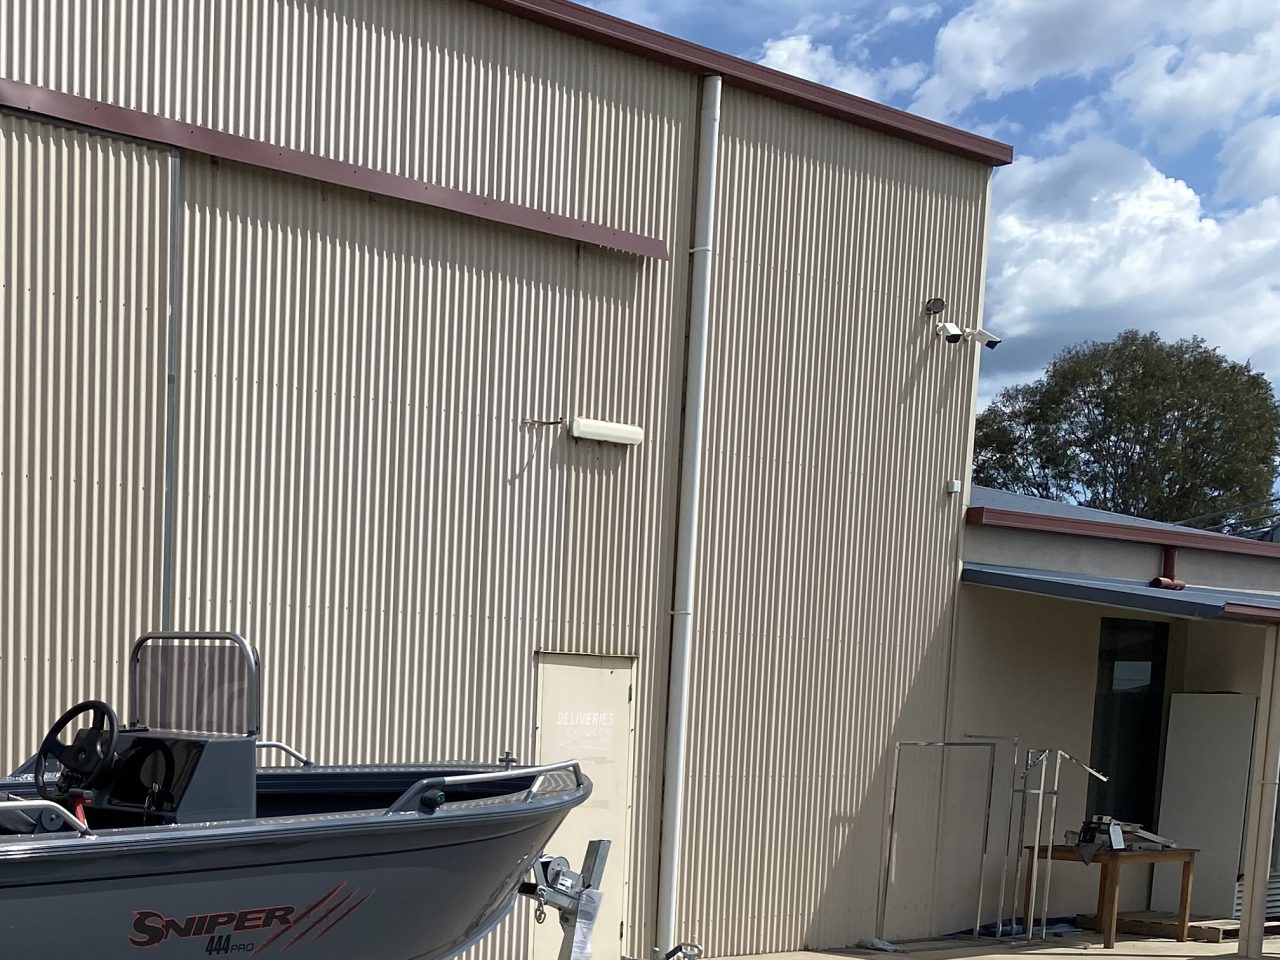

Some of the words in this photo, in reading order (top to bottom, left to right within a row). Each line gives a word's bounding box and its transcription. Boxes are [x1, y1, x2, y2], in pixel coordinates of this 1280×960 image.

[556, 711, 615, 726] DELIVERIES
[128, 905, 296, 947] SNIPER
[205, 934, 231, 955] 444
[230, 943, 254, 953] PRO
